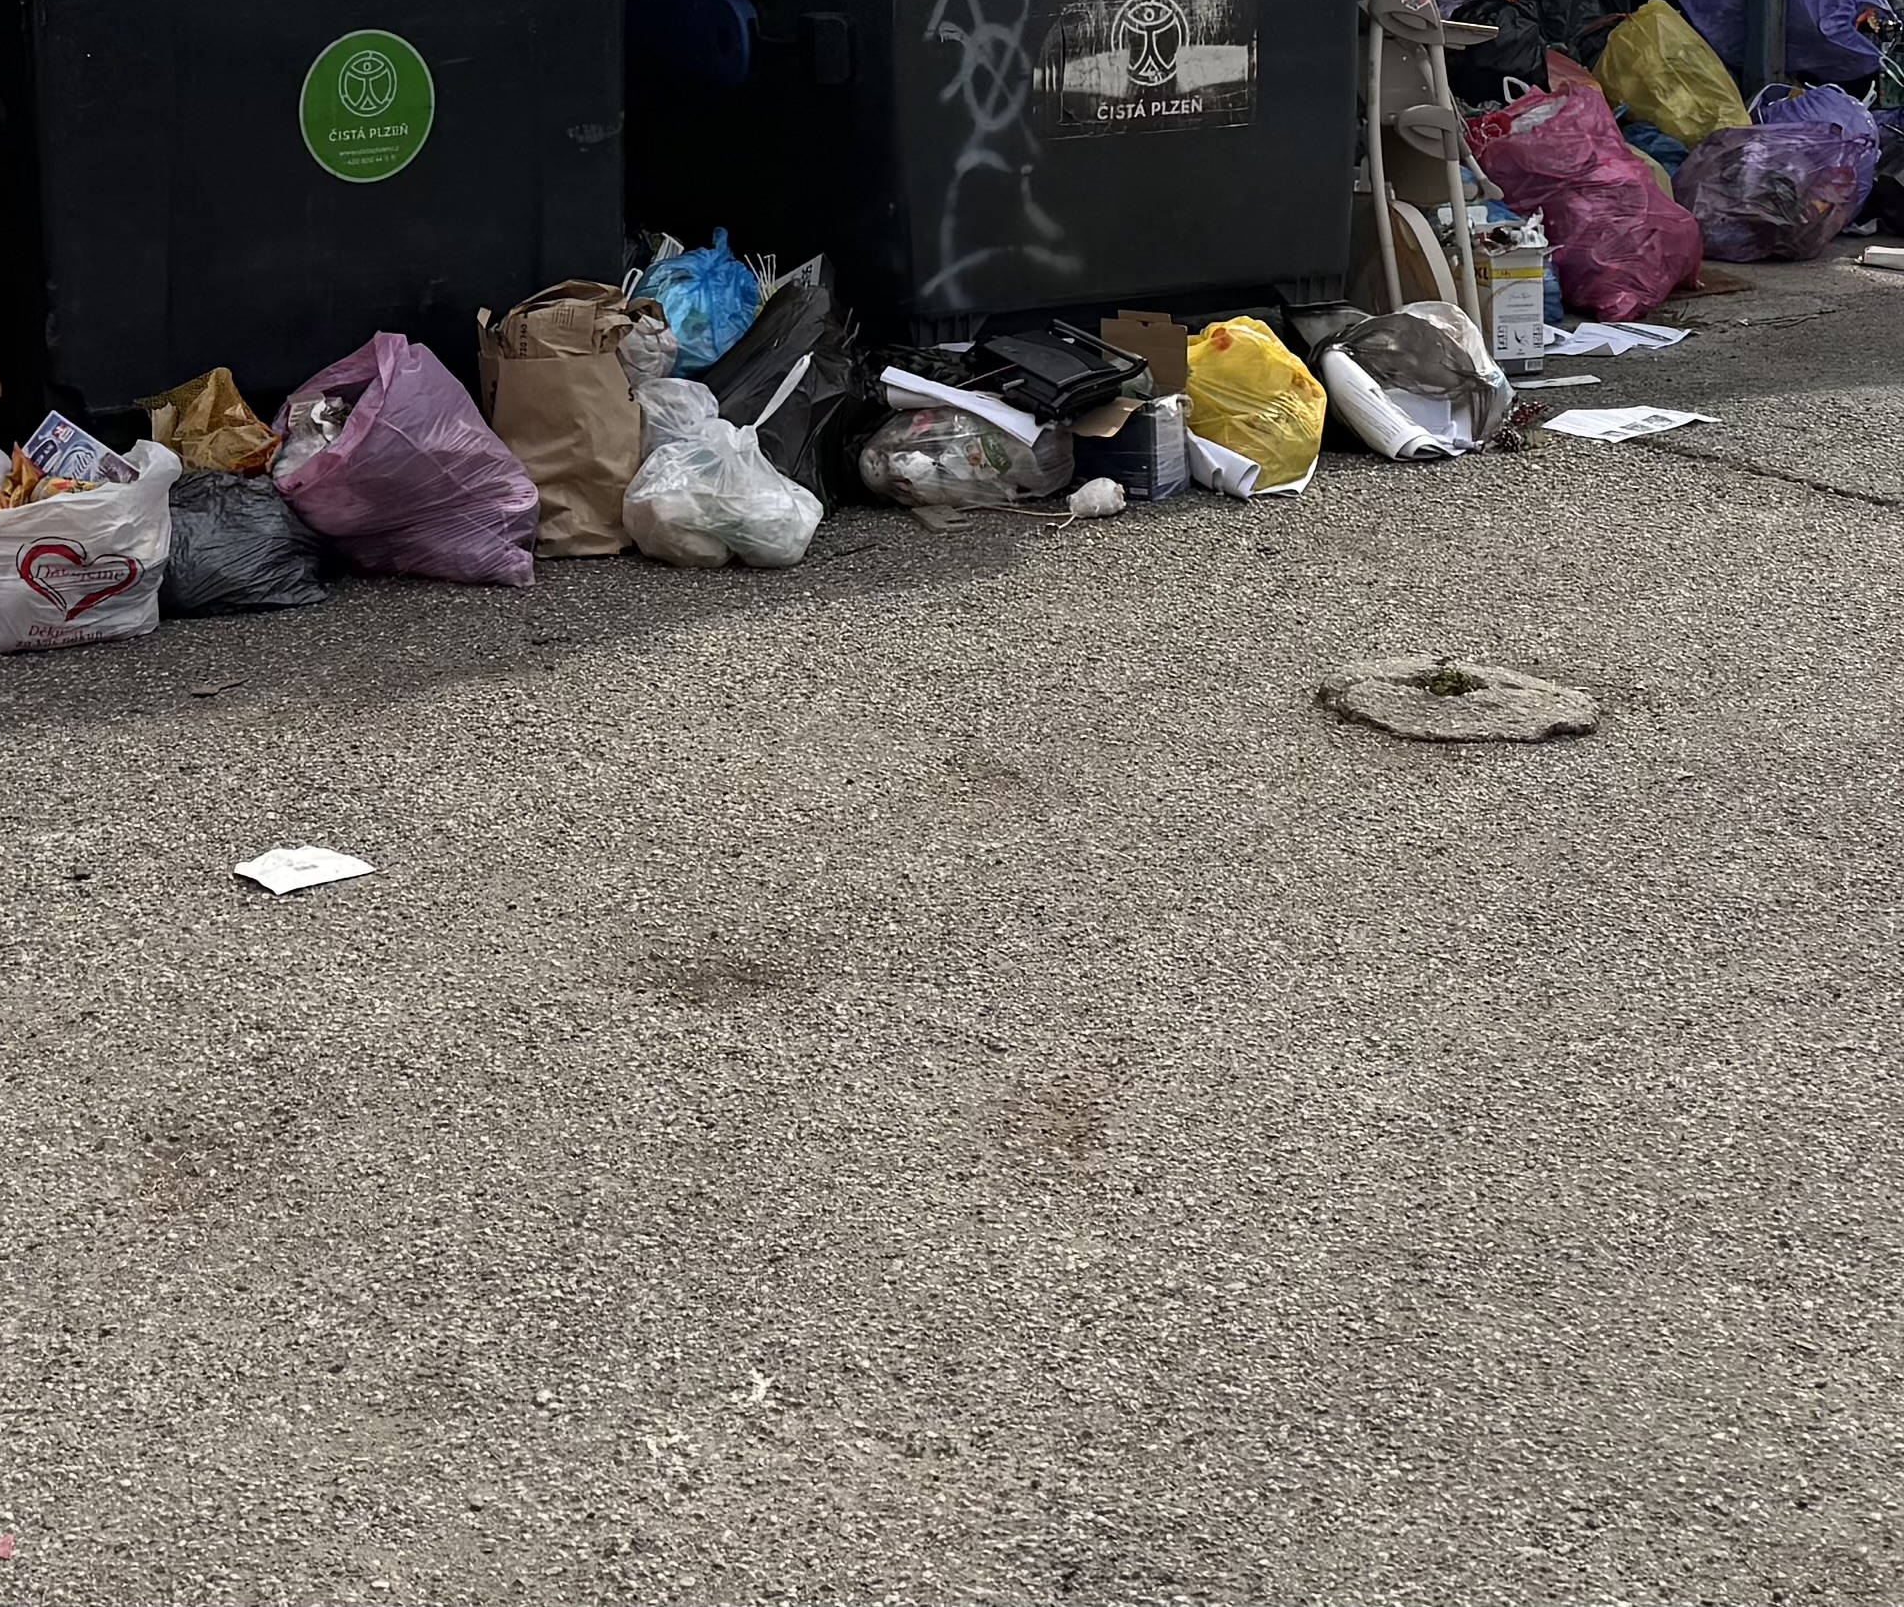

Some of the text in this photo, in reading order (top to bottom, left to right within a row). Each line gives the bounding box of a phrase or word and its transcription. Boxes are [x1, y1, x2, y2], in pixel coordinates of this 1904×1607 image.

[1097, 94, 1203, 121] ČISTÁ PLZEŇ
[328, 123, 409, 142] ČISTÁ PLZEŇ
